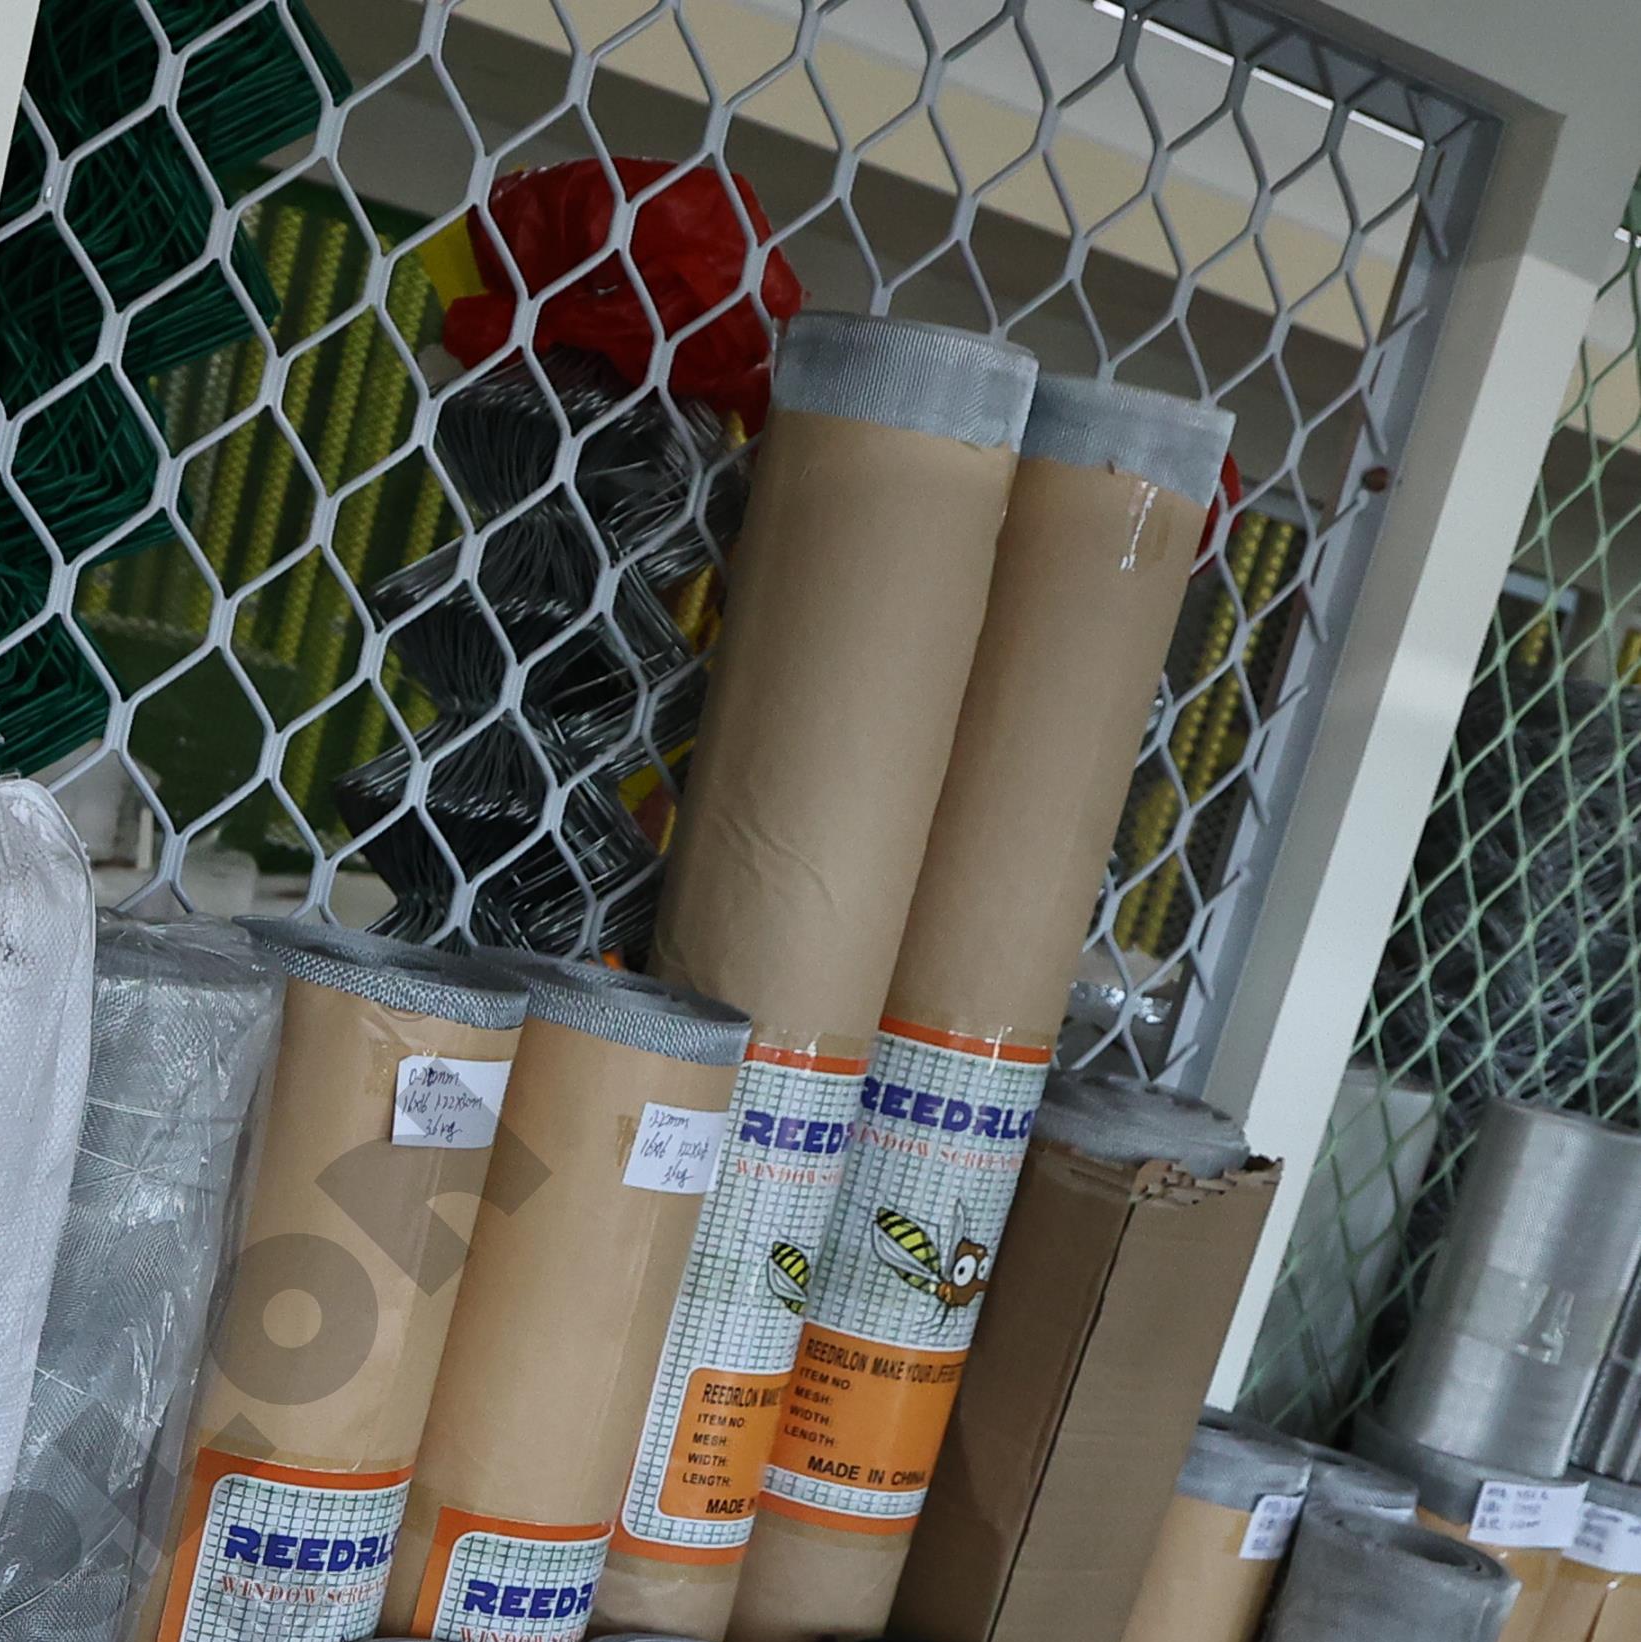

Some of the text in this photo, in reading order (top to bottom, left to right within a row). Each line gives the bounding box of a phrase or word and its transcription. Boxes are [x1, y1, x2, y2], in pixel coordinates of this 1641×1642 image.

[808, 1456, 861, 1481] MADE
[866, 1468, 885, 1485] IN
[224, 1524, 399, 1573] REEDRL
